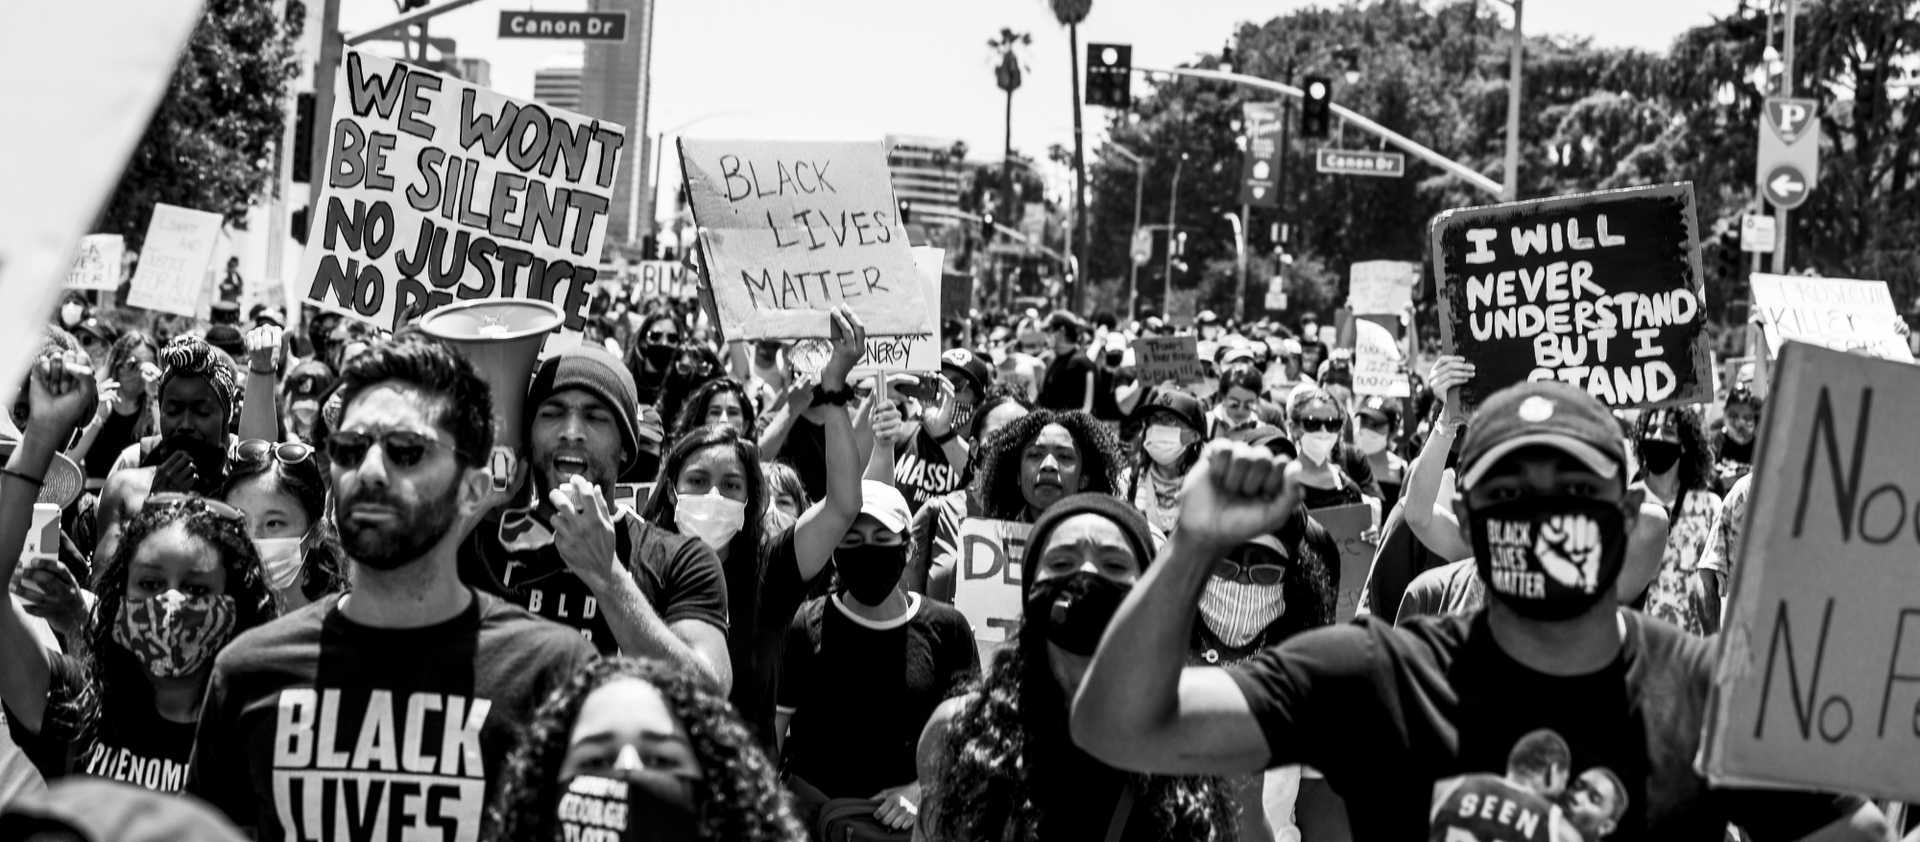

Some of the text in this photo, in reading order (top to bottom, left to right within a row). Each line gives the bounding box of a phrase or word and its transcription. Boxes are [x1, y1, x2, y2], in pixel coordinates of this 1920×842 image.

[510, 15, 614, 35] Canon Dr
[347, 51, 624, 188] WE WON'T
[1780, 104, 1806, 131] P
[720, 154, 836, 202] BLACK
[1326, 154, 1394, 171] Canon Dr
[329, 118, 609, 256] BE SILENT
[767, 209, 891, 250] LIVES
[1466, 214, 1626, 264] I WILL
[308, 255, 384, 316] NO
[323, 196, 395, 260] NO
[395, 217, 598, 332] JUSTICE
[642, 264, 684, 299] BLM
[1466, 260, 1606, 311] NEVER
[741, 266, 889, 310] MATTER
[1469, 288, 1698, 341] UNDERSTAND
[1533, 328, 1664, 368] BUT I
[1487, 519, 1532, 547] BLACK
[1492, 571, 1546, 599] MATTER
[273, 688, 492, 778] BLACK
[288, 777, 461, 842] LIVES
[1458, 793, 1539, 840] SEEN
